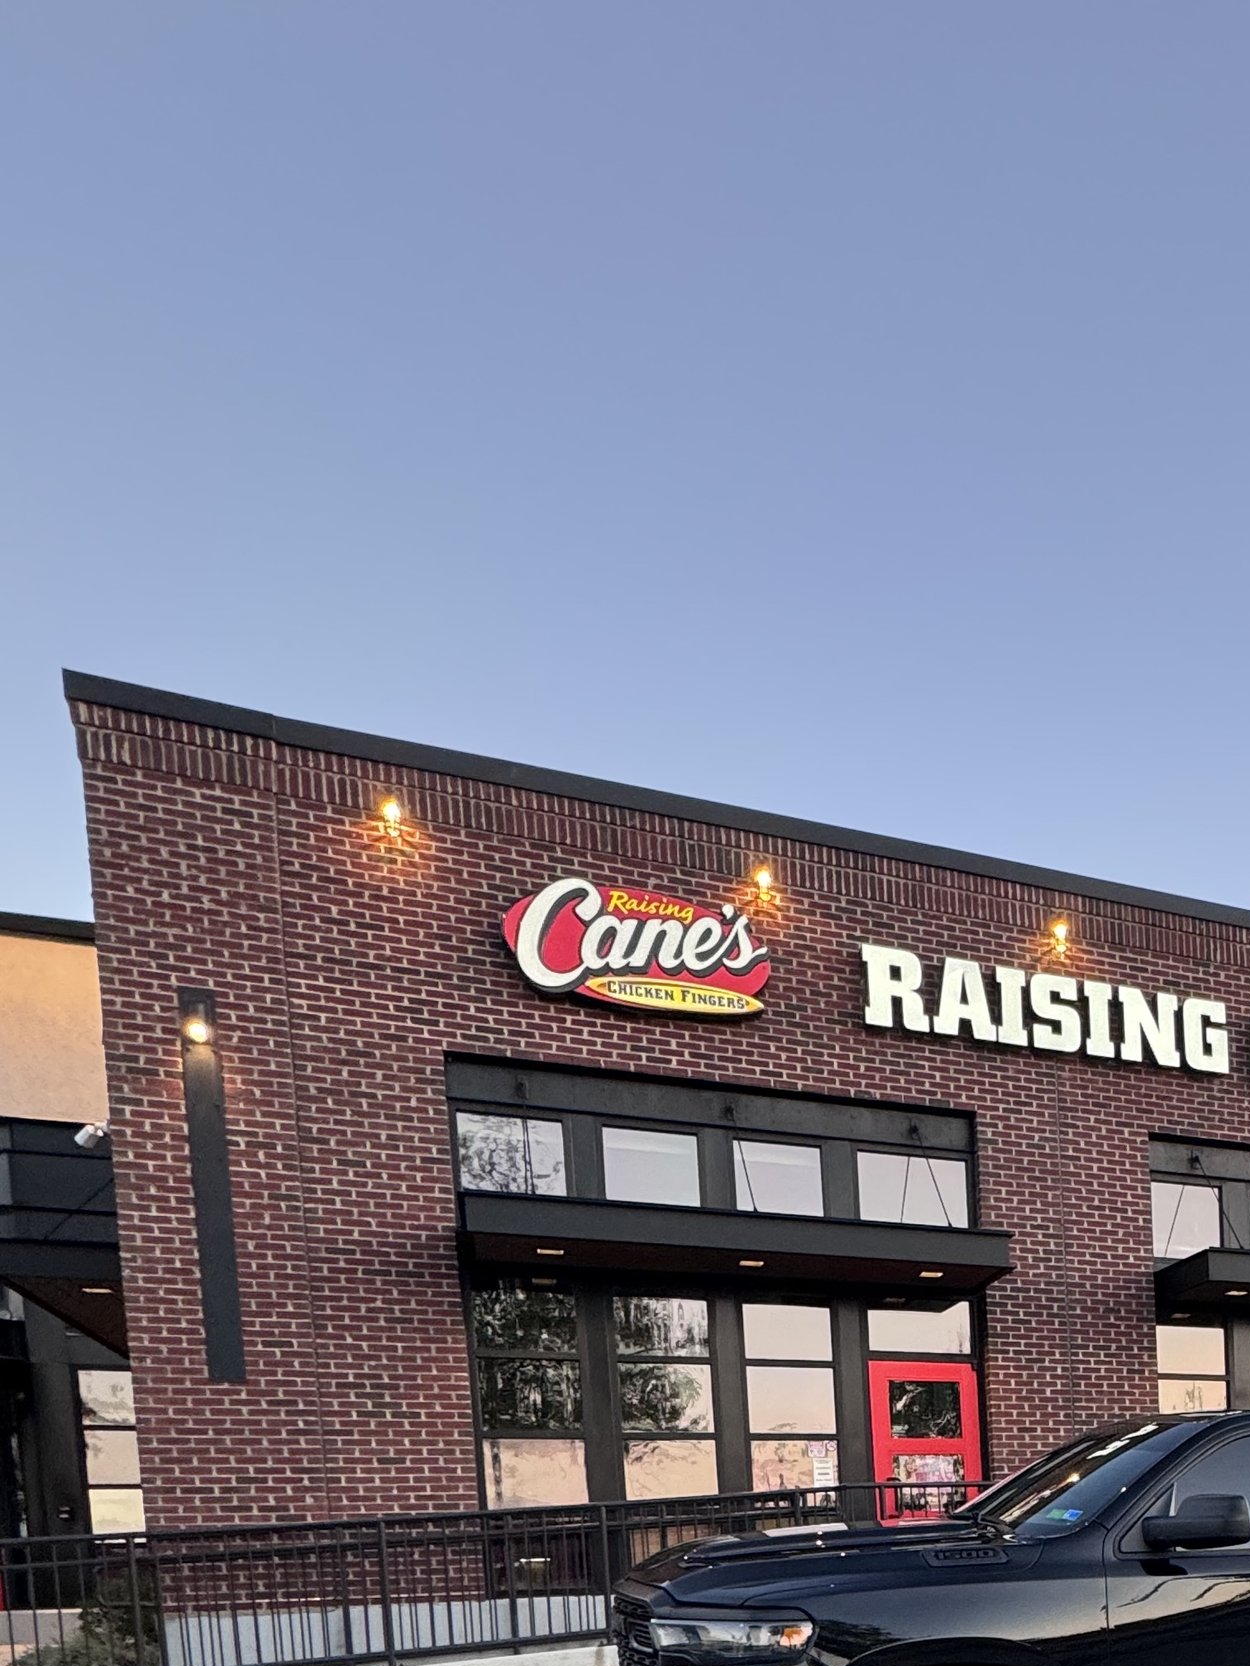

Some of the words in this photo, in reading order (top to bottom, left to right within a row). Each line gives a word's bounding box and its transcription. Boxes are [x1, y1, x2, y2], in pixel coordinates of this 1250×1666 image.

[607, 890, 694, 924] Raising
[516, 878, 769, 988] Cane's
[606, 980, 675, 1001] CHICKEN
[681, 989, 746, 1010] FINGERS
[861, 943, 1229, 1074] RAISING
[933, 1548, 996, 1561] 1500
